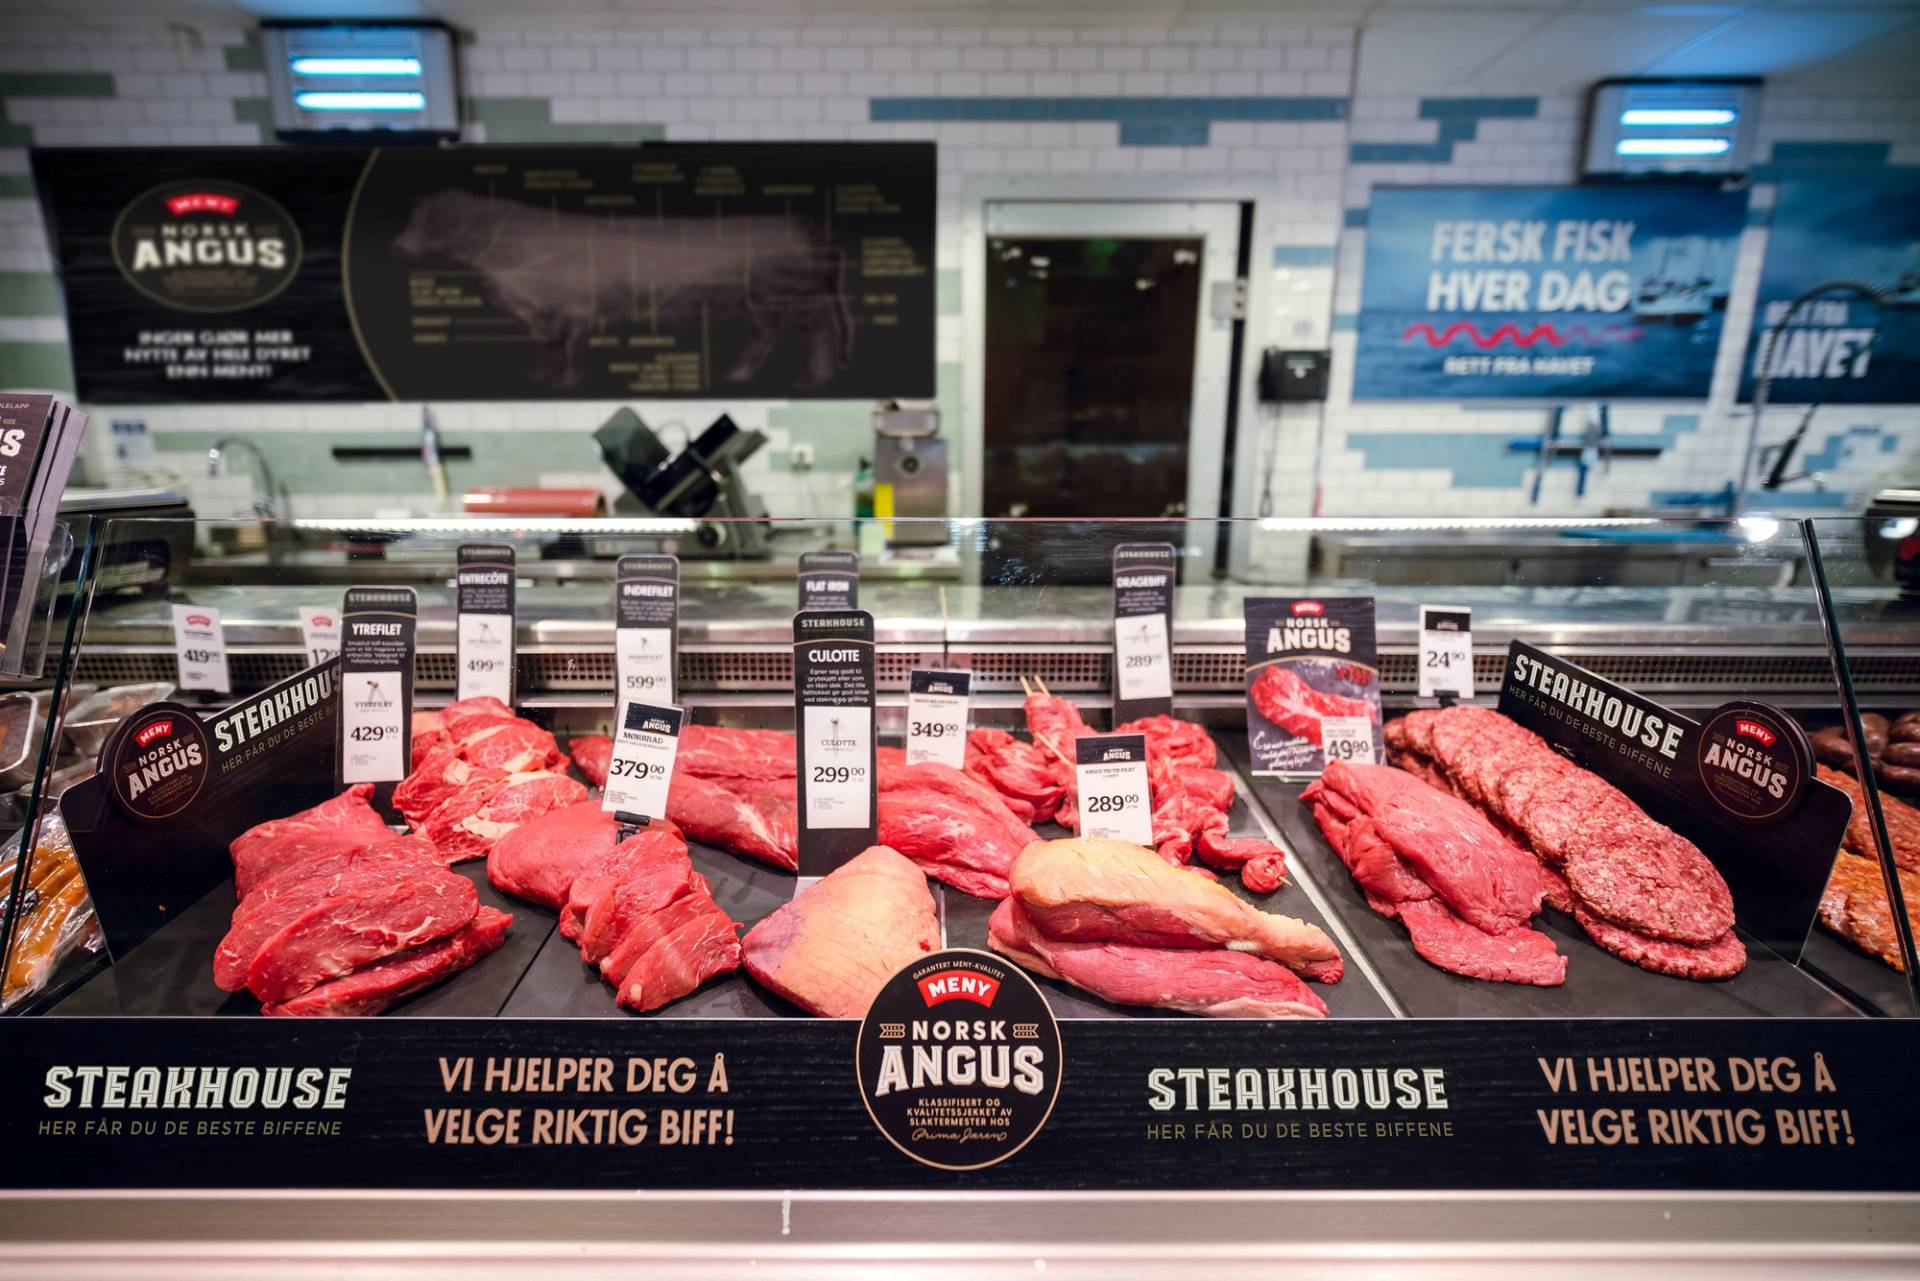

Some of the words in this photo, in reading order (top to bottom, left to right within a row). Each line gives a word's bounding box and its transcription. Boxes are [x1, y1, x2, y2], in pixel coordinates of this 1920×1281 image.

[162, 226, 246, 237] NORSK
[1430, 220, 1547, 263] FERSK
[1552, 220, 1636, 263] FISK
[133, 239, 286, 271] ANGUS
[1427, 269, 1531, 312] HVER
[1537, 269, 1633, 312] DAG
[184, 349, 208, 361] AV
[1492, 355, 1531, 375] FRA
[1533, 355, 1595, 375] HAVET
[623, 585, 674, 597] INDREFILET
[806, 580, 826, 592] FLAT
[827, 580, 849, 592] IRON
[352, 623, 402, 636] YTREFILET
[801, 617, 865, 628] STEAKHOUSE
[1286, 618, 1328, 628] NORSK
[1267, 628, 1351, 654] ANGUS
[808, 649, 860, 663] CULOTTE
[1513, 654, 1684, 761] STEAKHOUSE
[140, 723, 170, 743] MENY
[642, 720, 671, 734] ANGUS
[1509, 684, 1526, 700] HER
[1528, 694, 1546, 711] FÅR
[1550, 708, 1563, 720] DU
[1565, 714, 1579, 729] DE
[1582, 722, 1616, 748] BESTE
[1619, 743, 1673, 779] BIFFENE
[1740, 723, 1772, 742] MENY
[138, 738, 182, 766] NORSK
[221, 754, 242, 773] HER
[245, 742, 266, 760] FÅR
[267, 735, 281, 748] DU
[283, 725, 295, 739] DE
[821, 739, 857, 747] CULOTTE
[1726, 738, 1773, 767] NORSK
[1103, 751, 1131, 761] ANGUS
[128, 743, 203, 800] ANGUS
[1704, 742, 1787, 799] ANGUS
[912, 961, 951, 980] GARANTERT
[953, 961, 1005, 980] MENY-KVALITET
[928, 977, 992, 998] MENY
[912, 1020, 1007, 1041] NORSK
[438, 1057, 474, 1093] VI
[484, 1057, 614, 1093] HJELPER
[626, 1057, 698, 1093] DEG
[707, 1052, 729, 1092] Å
[875, 1045, 1044, 1097] ANGUS
[1538, 1057, 1578, 1093] VI
[1587, 1057, 1721, 1092] HJELPER
[1728, 1057, 1800, 1092] DEG
[1814, 1051, 1837, 1092] Å
[43, 1066, 352, 1110] STEAKHOUSE
[1148, 1068, 1449, 1111] STEAKHOUSE
[907, 1107, 996, 1117] KVALITETSSJEKKET
[1000, 1107, 1013, 1117] AV
[919, 1098, 982, 1107] KLASSIFISERT
[986, 1098, 1001, 1107] OG
[39, 1120, 76, 1136] HER
[84, 1117, 123, 1136] FÅR
[130, 1120, 157, 1136] DU
[164, 1120, 189, 1136] DE
[196, 1120, 256, 1136] BESTE
[263, 1120, 343, 1136] BIFFENE
[424, 1108, 522, 1145] VELGE
[532, 1108, 649, 1145] RIKTIG
[660, 1108, 735, 1146] BIFF!
[909, 1117, 986, 1127] SLAKTERMESTER
[990, 1117, 1010, 1127] HOS
[1147, 1124, 1186, 1140] HER
[1194, 1119, 1233, 1139] FÅR
[1241, 1123, 1268, 1139] DU
[1276, 1123, 1301, 1138] DE
[1309, 1122, 1368, 1138] BESTE
[1376, 1121, 1454, 1137] BIFFENE
[1536, 1108, 1640, 1145] VELGE
[1648, 1108, 1766, 1145] RIKTIG
[1774, 1108, 1856, 1146] BIFF!
